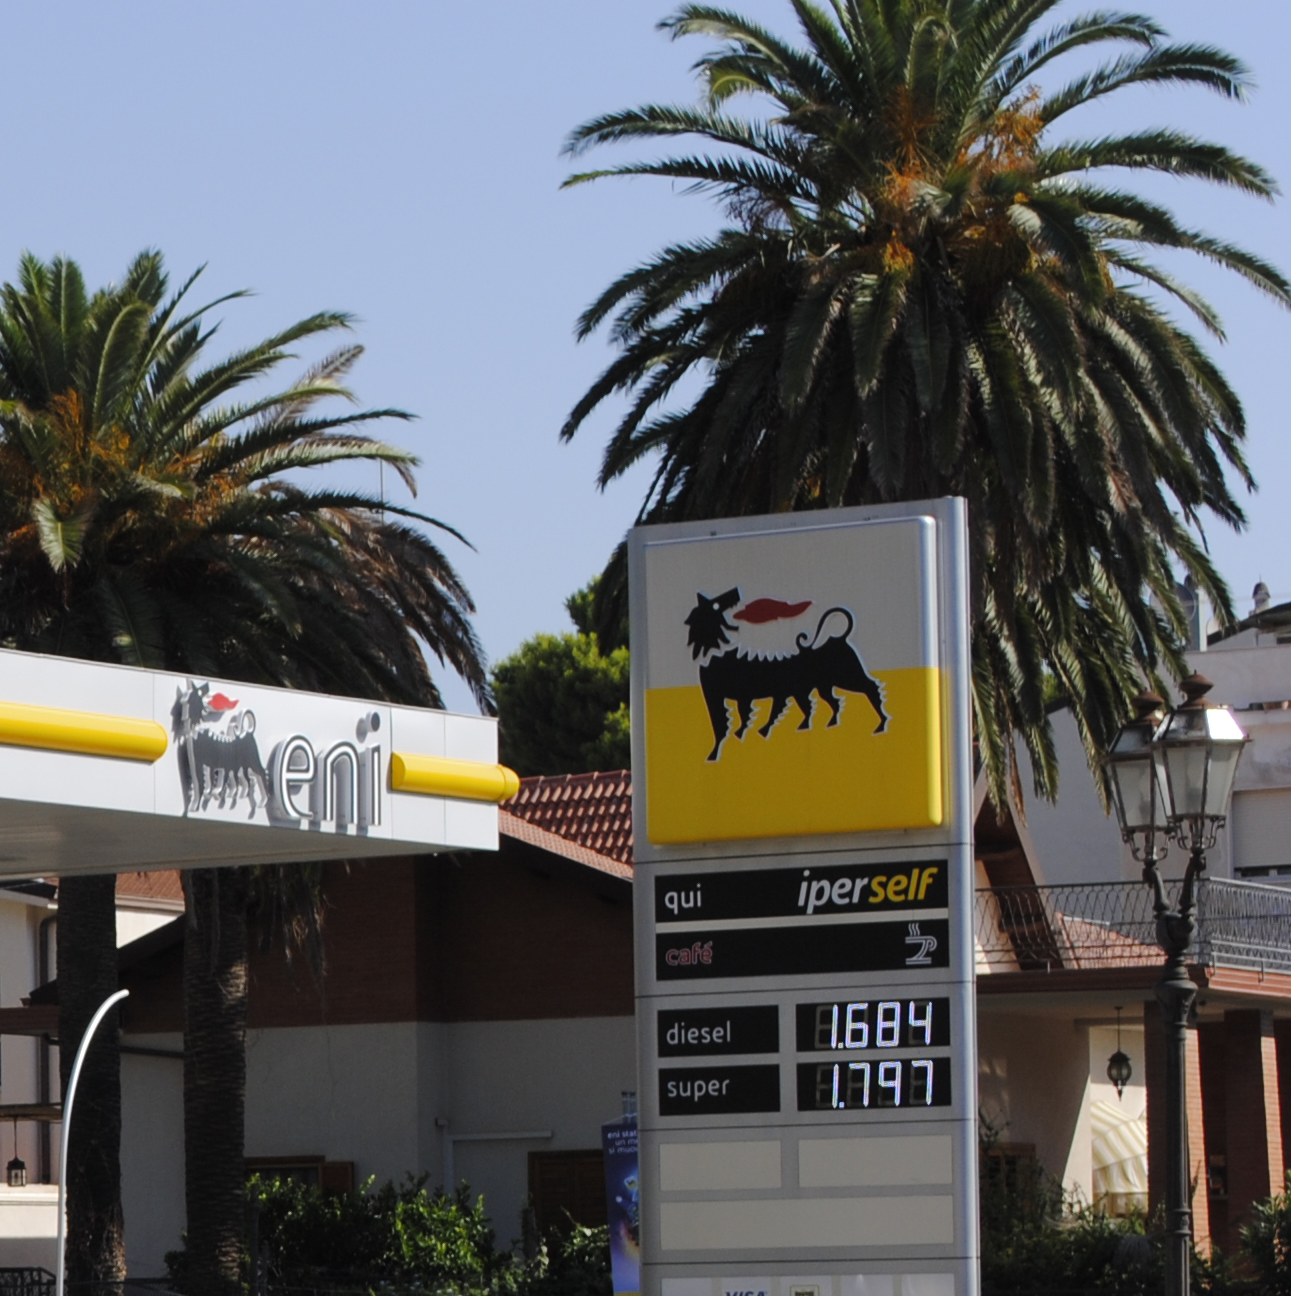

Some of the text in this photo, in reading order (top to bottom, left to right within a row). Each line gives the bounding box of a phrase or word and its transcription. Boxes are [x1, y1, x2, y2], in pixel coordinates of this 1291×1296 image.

[277, 711, 382, 827] eni
[664, 867, 939, 915] qui iperself
[665, 941, 714, 967] café
[666, 1001, 933, 1049] diesel 1.684
[666, 1060, 934, 1109] super 1.797
